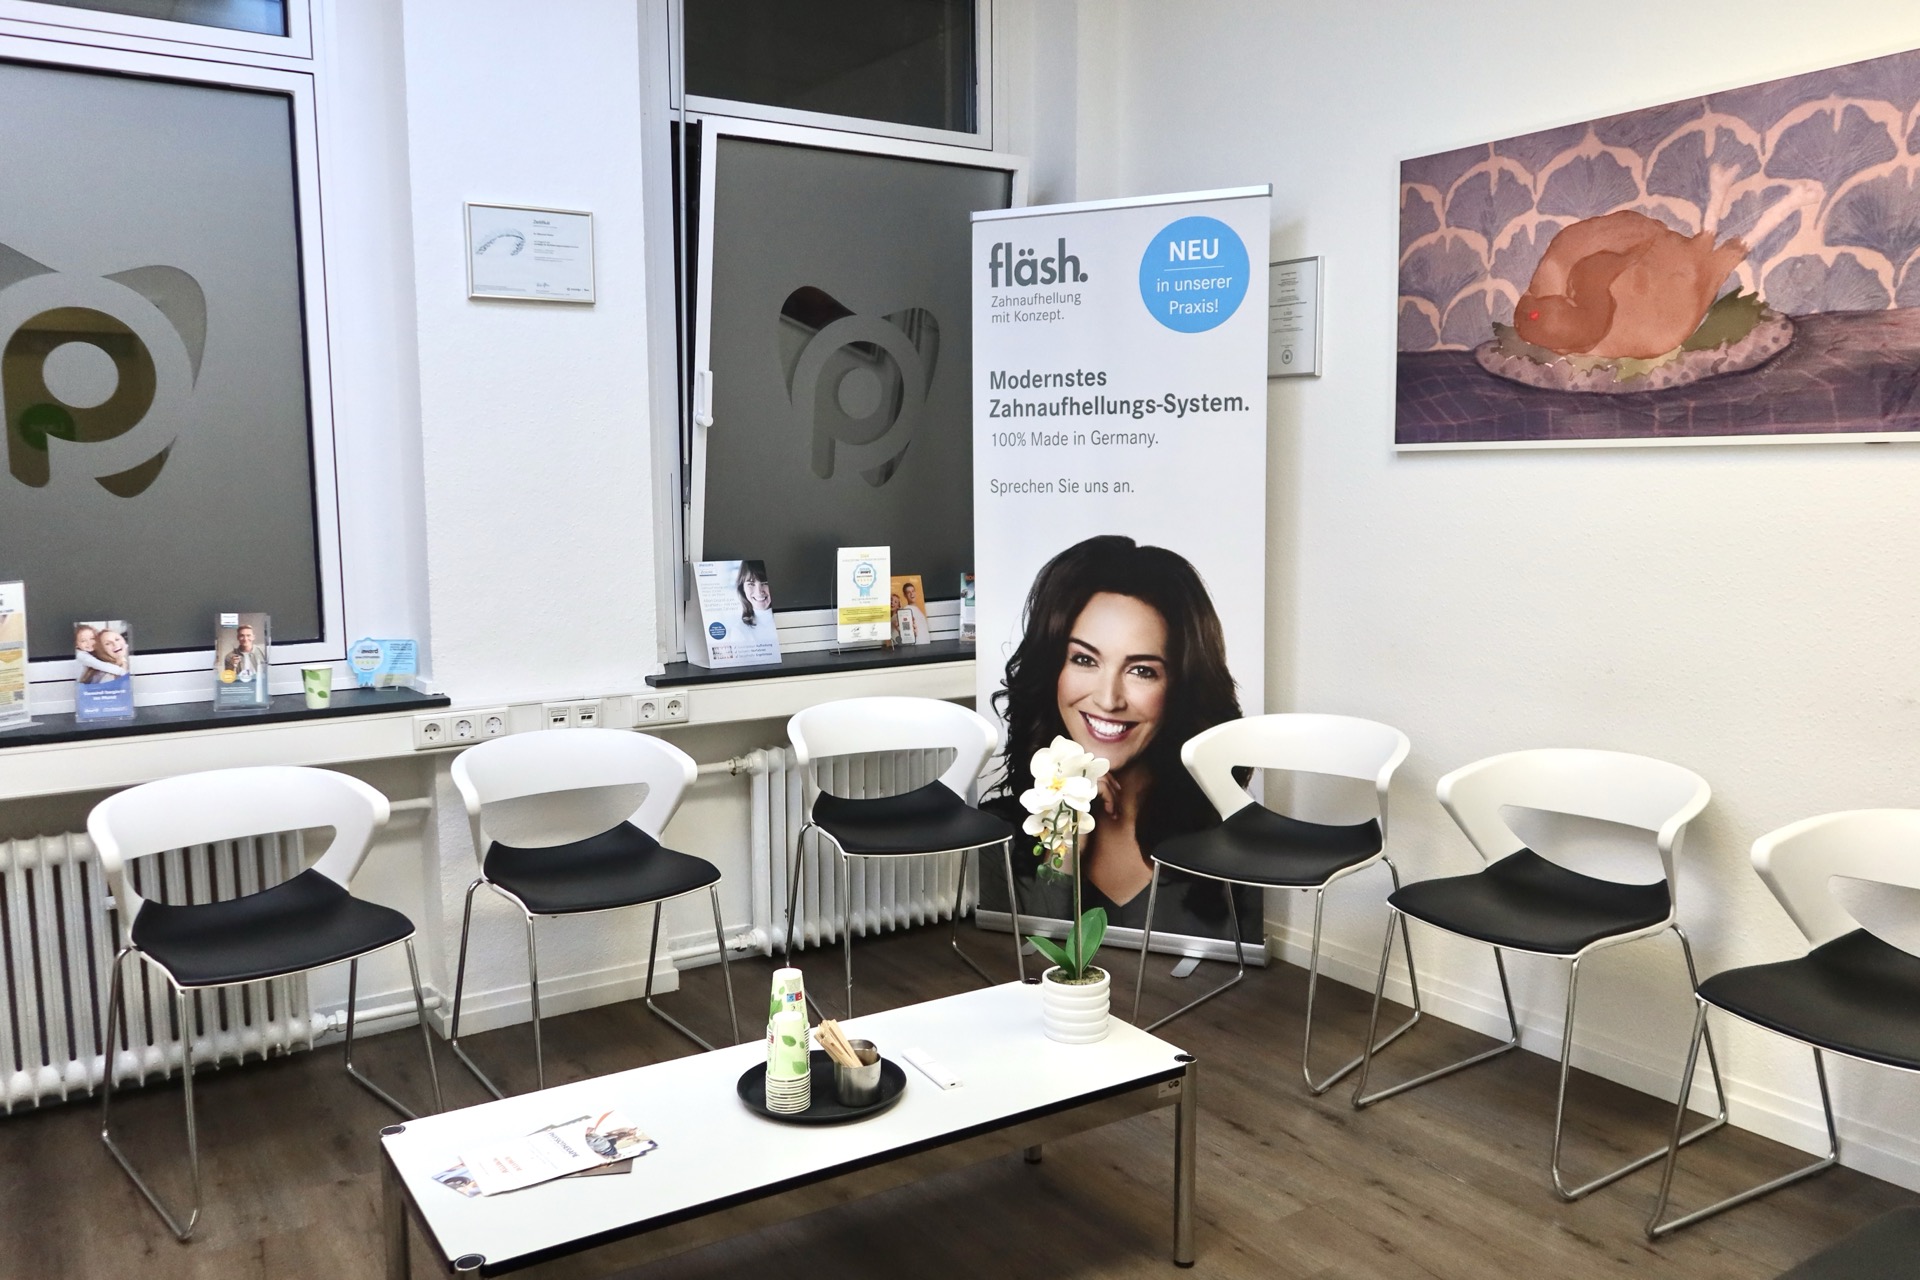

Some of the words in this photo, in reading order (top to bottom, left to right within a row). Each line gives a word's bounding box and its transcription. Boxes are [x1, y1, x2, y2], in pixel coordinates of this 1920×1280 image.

[1169, 237, 1219, 262] NEU
[988, 236, 1089, 288] fläsh.
[1156, 278, 1170, 293] in
[1174, 276, 1233, 292] unserer
[991, 291, 1082, 309] Zahnaufhellung
[1169, 298, 1219, 315] Praxis!
[991, 311, 1011, 324] mit
[1014, 309, 1065, 325] Konzept.
[990, 368, 1107, 390] Modernstes
[989, 392, 1250, 420] Zahnaufhellungs-System.
[991, 431, 1027, 447] 100%
[1031, 431, 1069, 447] Made
[1073, 430, 1086, 446] in
[1090, 429, 1159, 449] Germany.
[990, 478, 1054, 497] Sprechen
[1058, 478, 1080, 494] Sie
[1084, 481, 1109, 494] uns
[1113, 481, 1135, 494] an.
